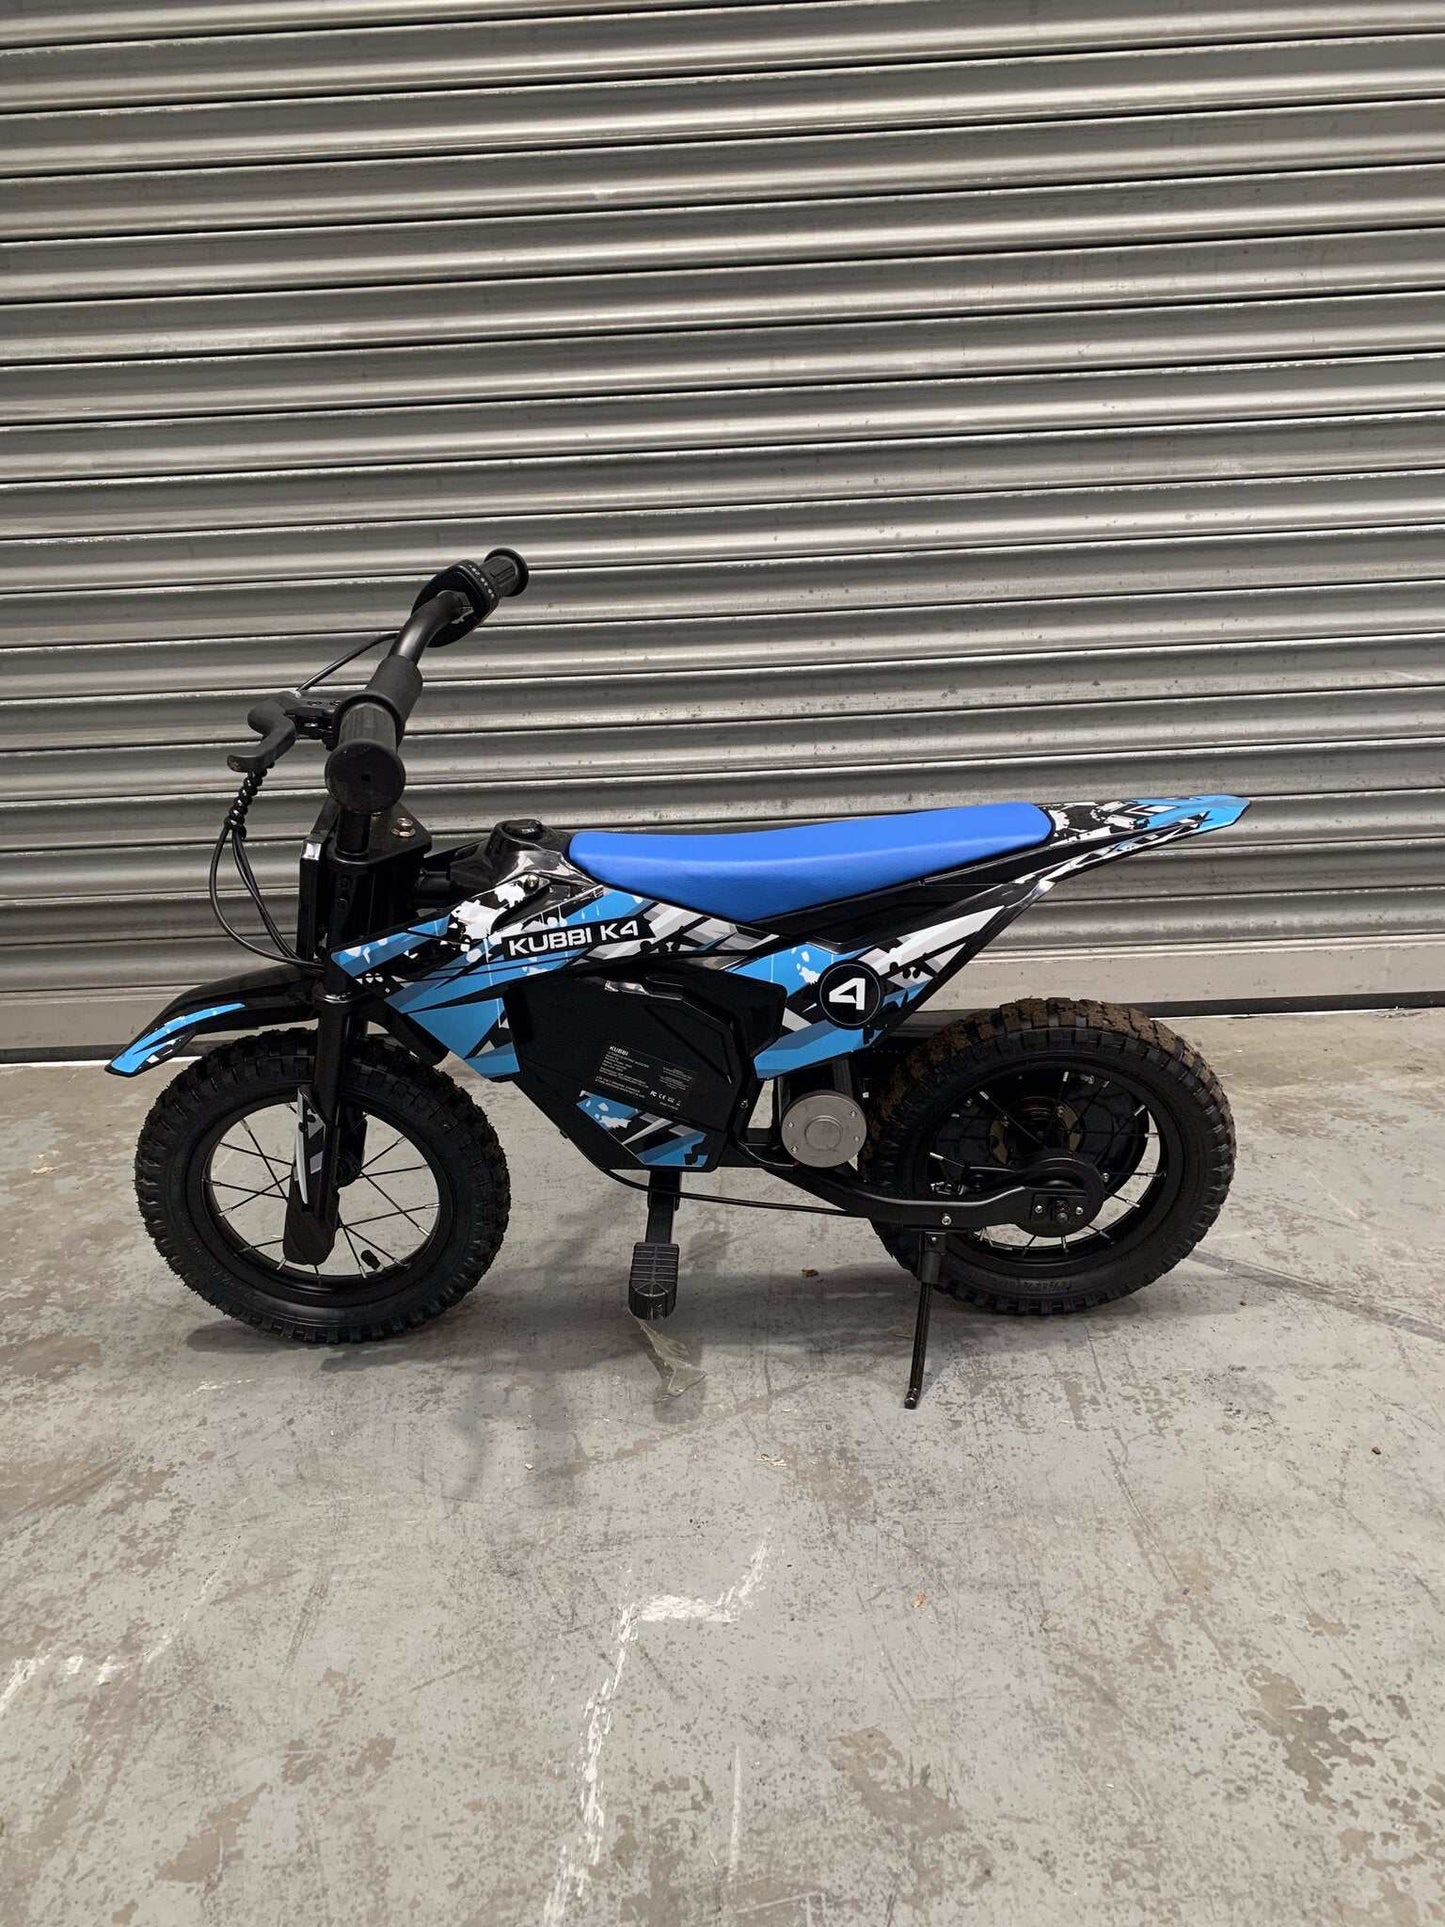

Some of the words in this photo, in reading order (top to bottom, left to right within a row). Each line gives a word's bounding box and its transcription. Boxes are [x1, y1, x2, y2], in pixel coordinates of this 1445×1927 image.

[509, 927, 593, 956] KUBBI
[600, 920, 639, 941] K4
[829, 977, 866, 1011] 4
[609, 1045, 629, 1056] KUBBI
